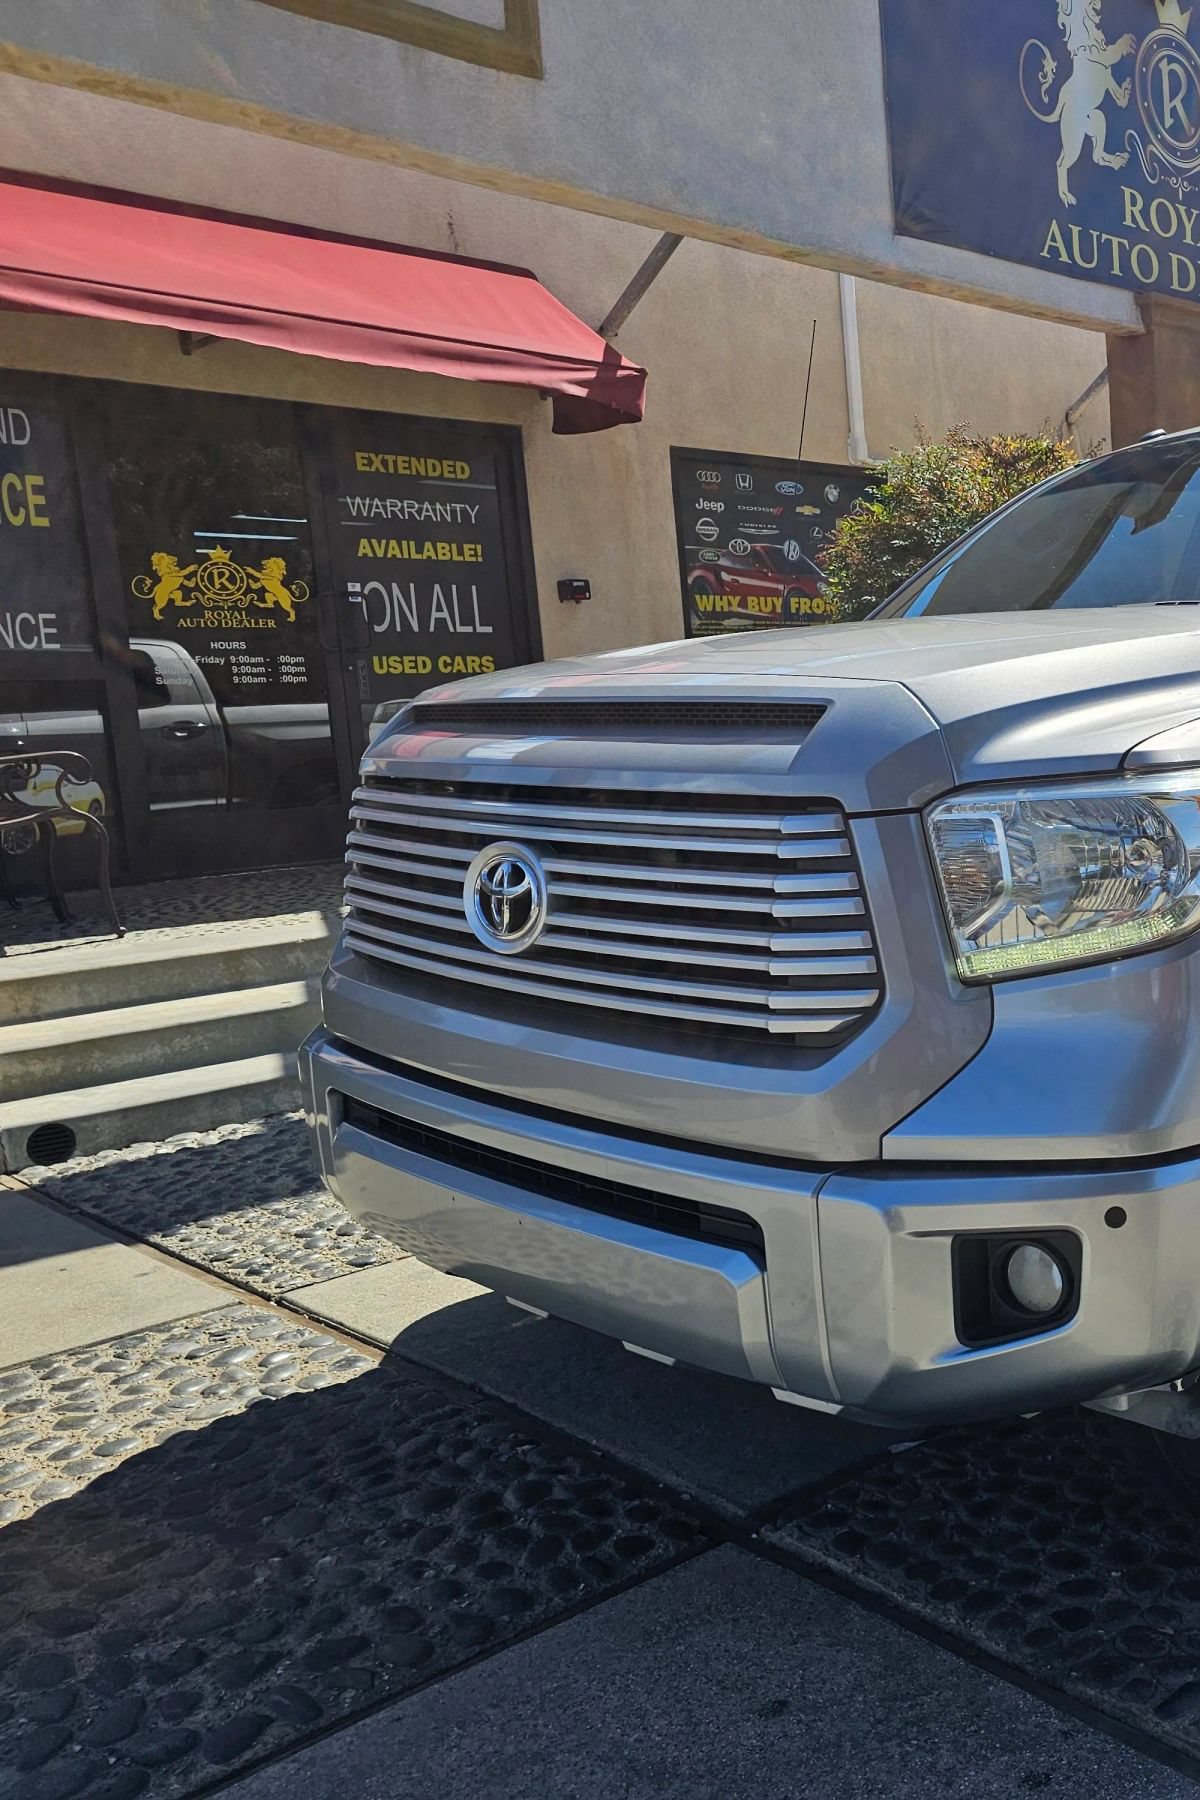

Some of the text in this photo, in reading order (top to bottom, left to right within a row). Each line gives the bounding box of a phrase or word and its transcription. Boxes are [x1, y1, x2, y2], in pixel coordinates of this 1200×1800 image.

[1040, 219, 1160, 284] AUTO
[0, 408, 31, 446] D
[355, 451, 471, 480] EXTENDED
[0, 472, 50, 527] CE
[695, 498, 725, 513] Jeep
[346, 496, 480, 524] WARRANTY
[357, 538, 483, 562] AVAILABLE!
[362, 581, 493, 633] ON ALL
[695, 594, 741, 613] WHY
[747, 596, 784, 614] BUY
[177, 618, 277, 629] AUTO DEALER
[204, 610, 250, 620] ROYAL
[210, 641, 247, 650] HOURS
[230, 656, 264, 664] 9:00am
[231, 665, 265, 674] 9:00am
[372, 656, 495, 674] USED CARS
[155, 676, 194, 687] Sunday
[233, 675, 267, 684] 9:00am
